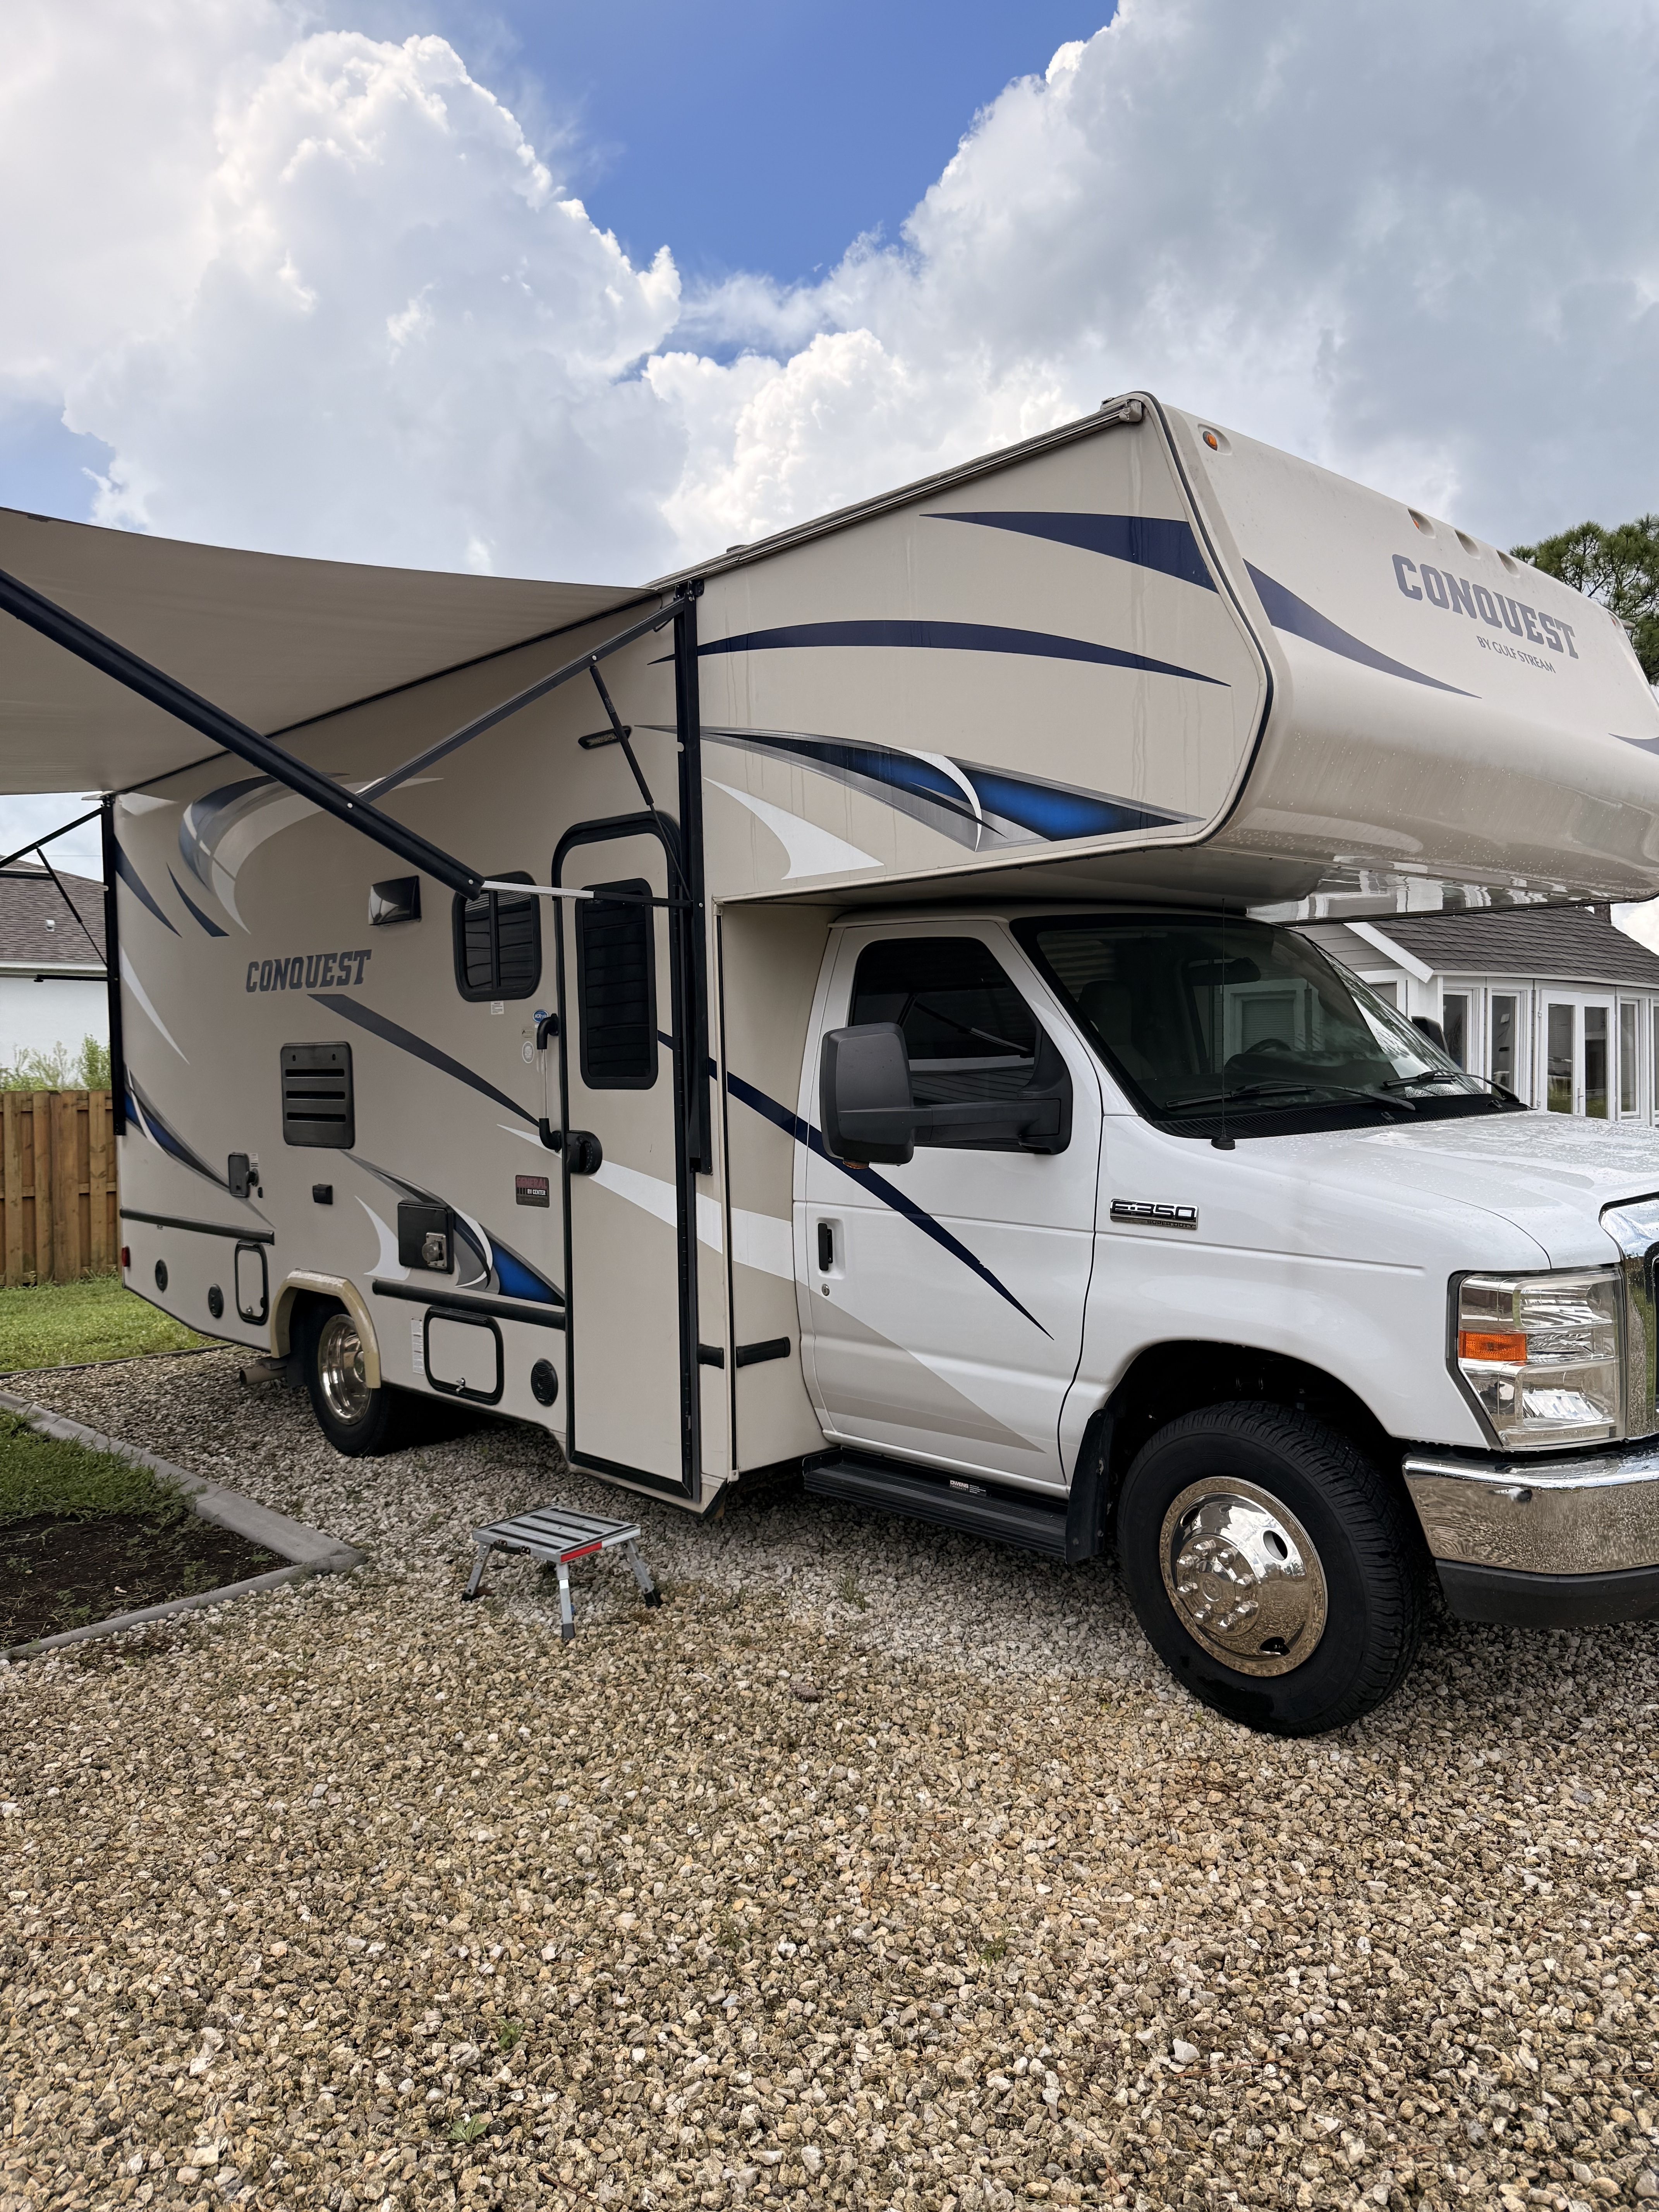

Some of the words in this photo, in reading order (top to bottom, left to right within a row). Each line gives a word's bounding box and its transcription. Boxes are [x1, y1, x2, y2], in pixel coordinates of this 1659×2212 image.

[1392, 554, 1578, 659] CONQUEST
[1476, 635, 1491, 650] BY
[1492, 641, 1516, 659] GULF
[1517, 651, 1556, 673] STREAM
[246, 949, 372, 993] CONQUEST
